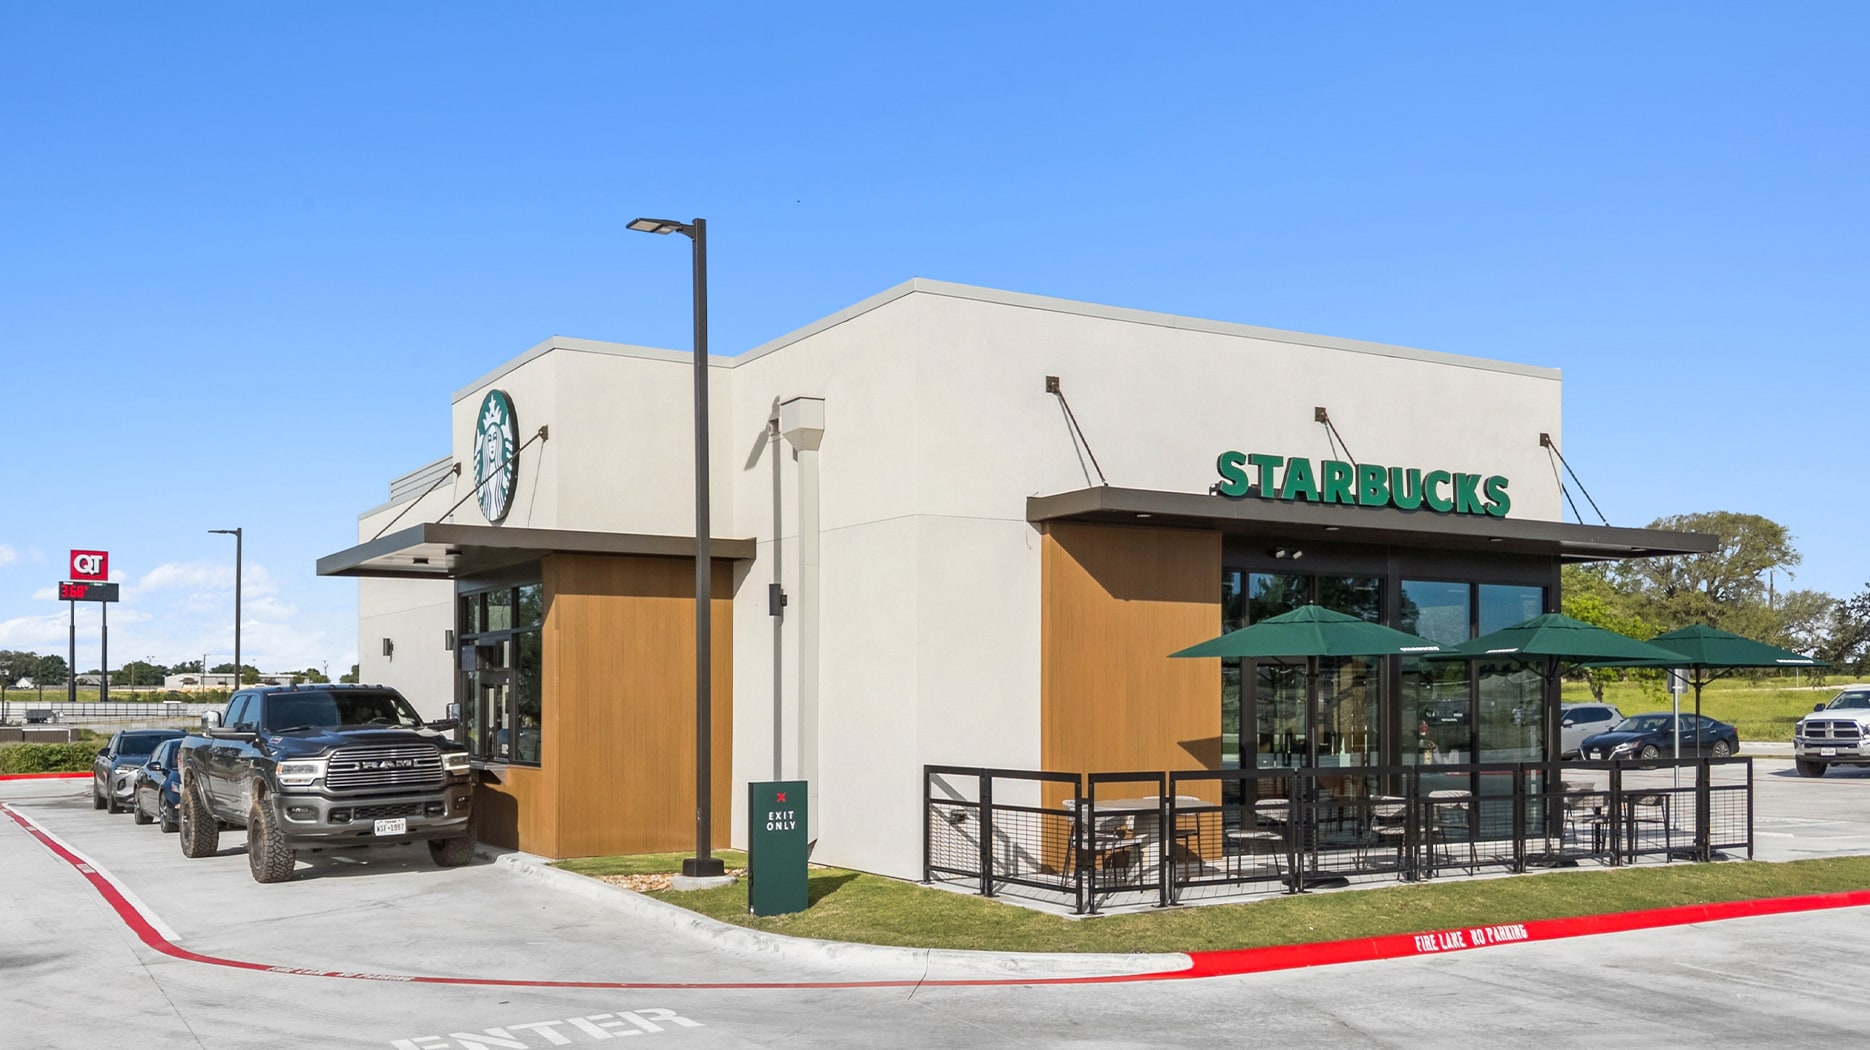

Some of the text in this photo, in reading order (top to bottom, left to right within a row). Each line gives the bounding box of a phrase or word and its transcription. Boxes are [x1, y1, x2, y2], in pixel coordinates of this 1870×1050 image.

[1217, 450, 1510, 517] STARBUCKS
[74, 554, 103, 575] QT
[362, 760, 412, 769] RAM
[768, 810, 794, 820] EXIT
[766, 821, 796, 831] ONLY
[1414, 924, 1528, 952] FIRE LANE NO PARKING
[389, 1007, 707, 1050] ENTER
